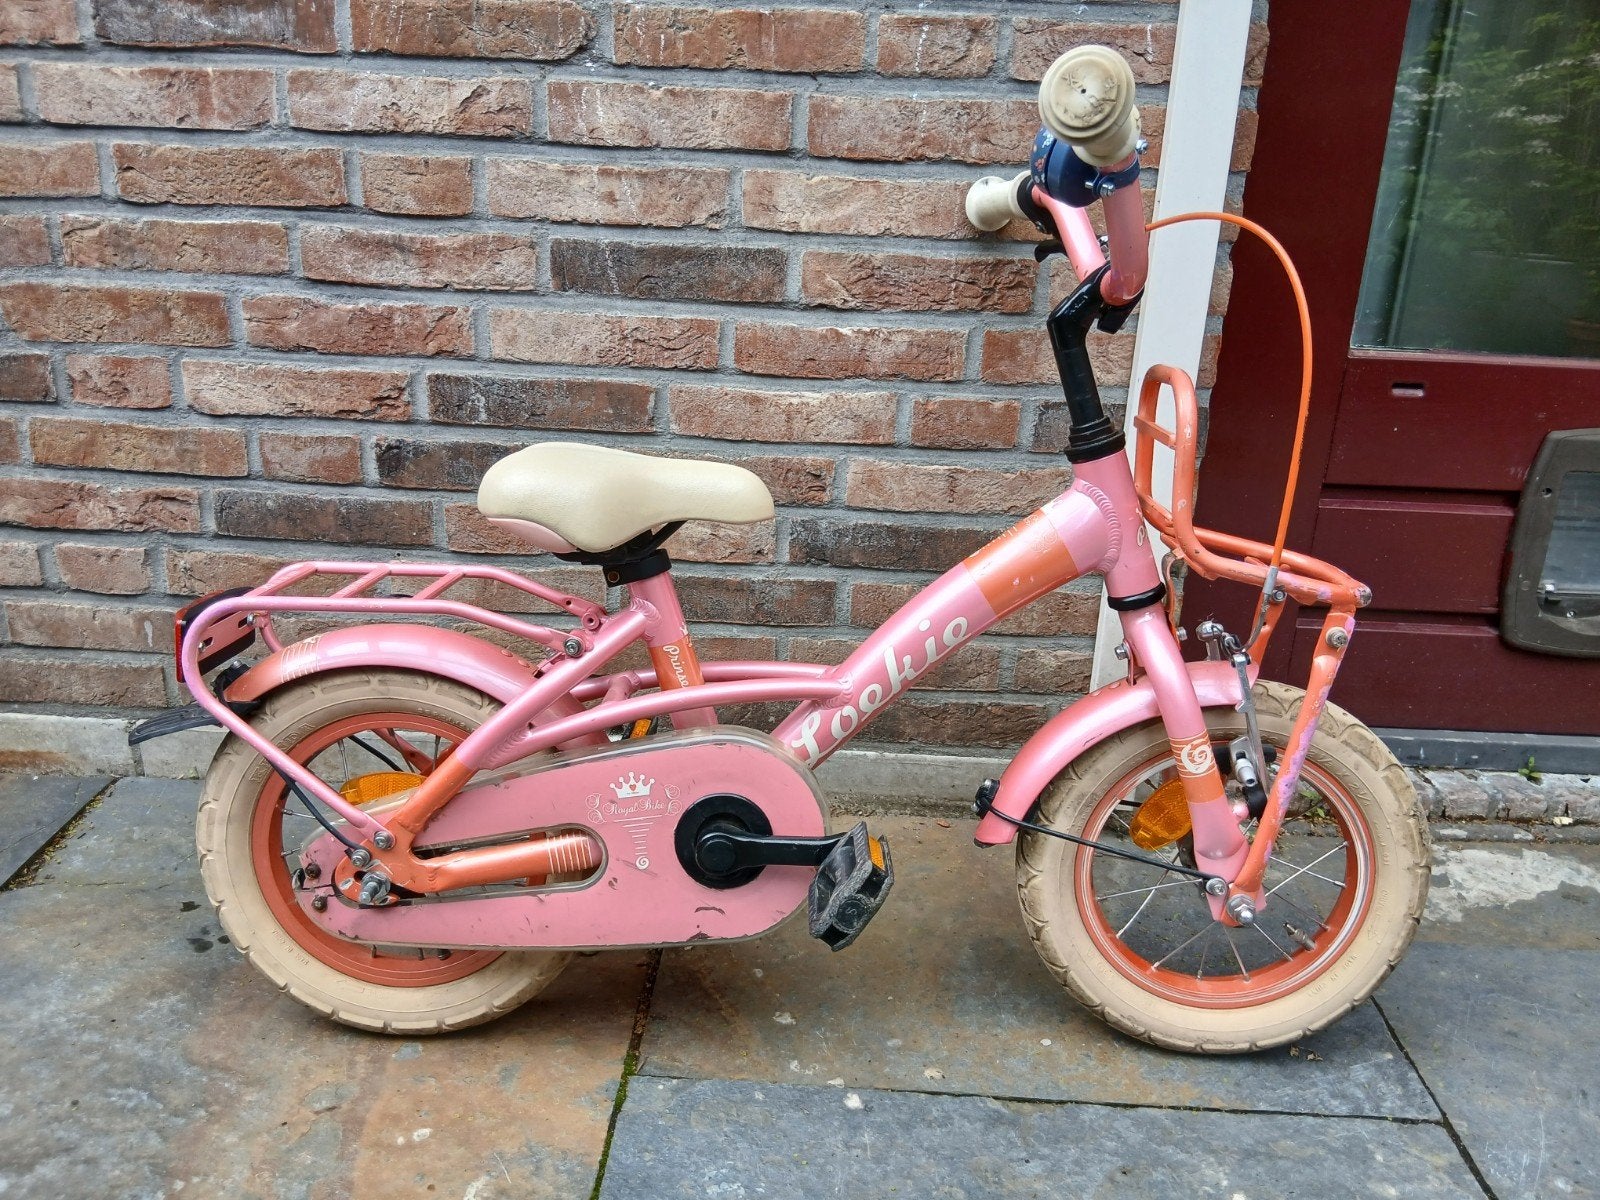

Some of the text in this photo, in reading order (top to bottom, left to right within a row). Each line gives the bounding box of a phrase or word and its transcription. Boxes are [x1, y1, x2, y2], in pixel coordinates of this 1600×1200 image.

[662, 644, 690, 688] Prinse
[791, 616, 972, 765] Loekie
[602, 798, 665, 816] Royal Bike
